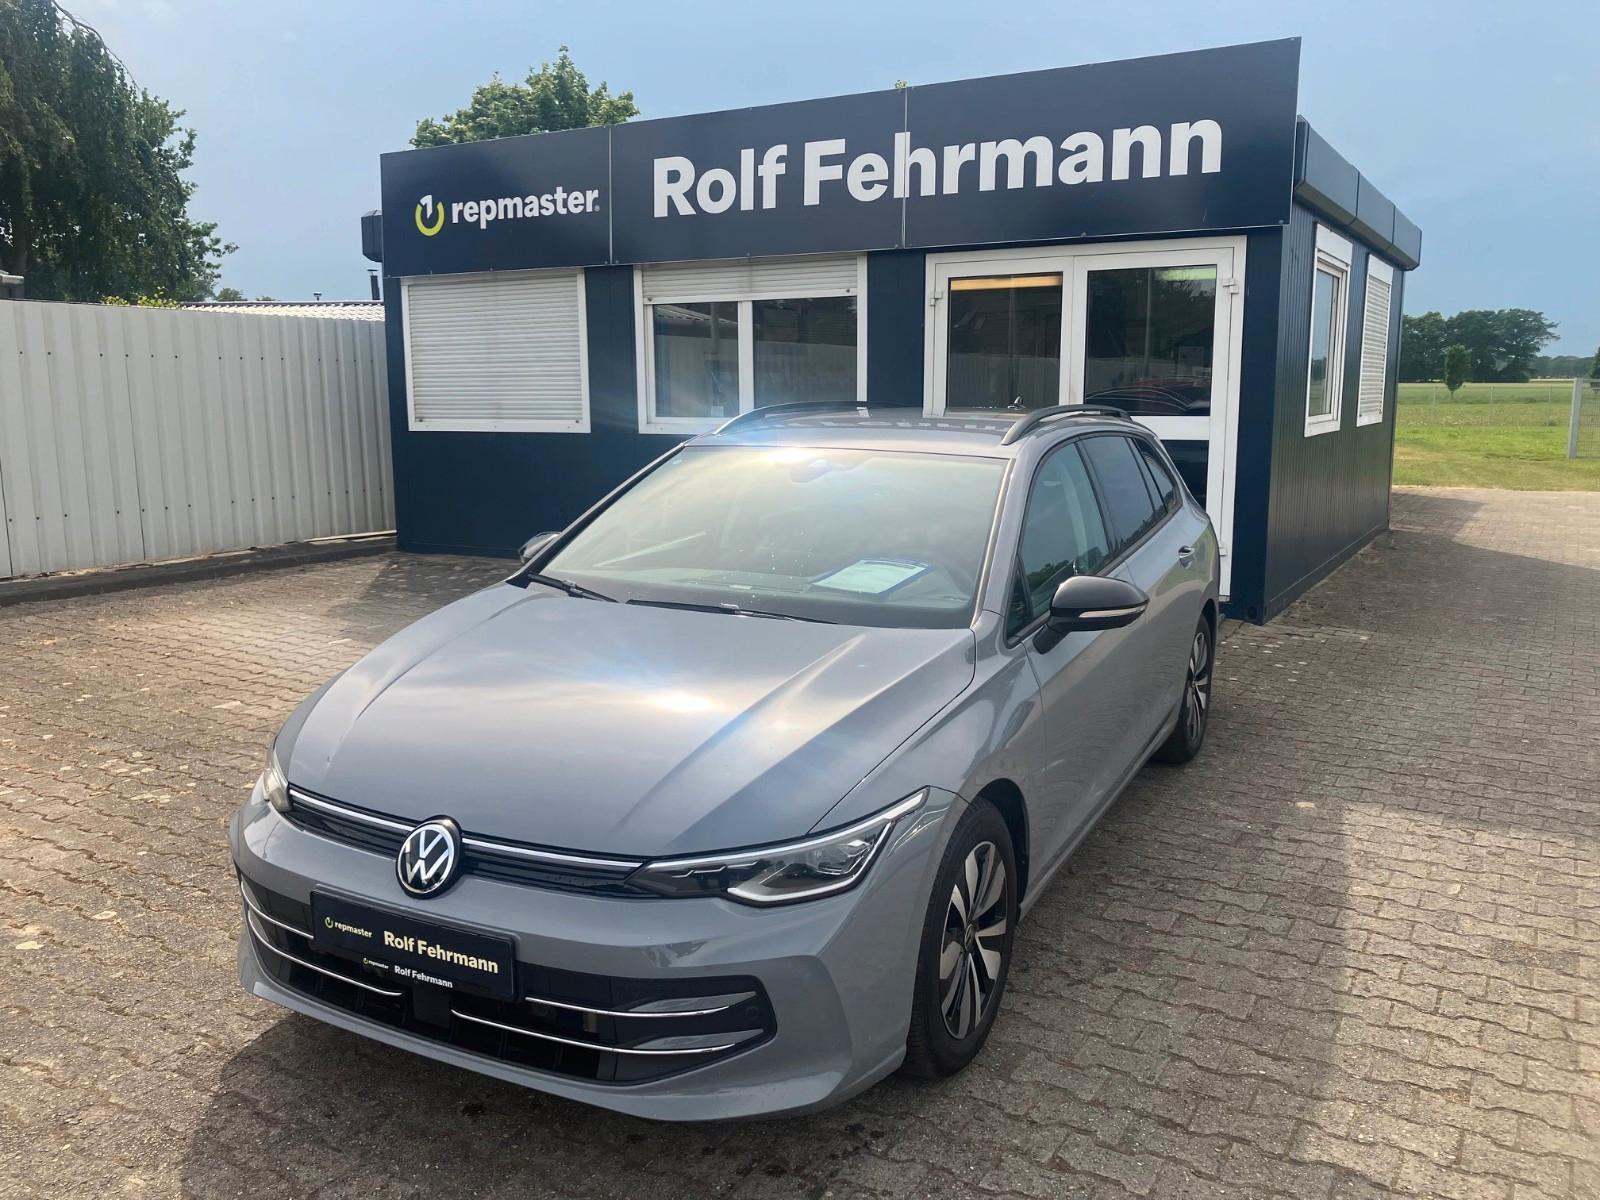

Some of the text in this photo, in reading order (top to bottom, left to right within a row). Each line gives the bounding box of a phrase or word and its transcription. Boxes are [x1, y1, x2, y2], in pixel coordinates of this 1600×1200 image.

[652, 118, 1223, 218] Rolf Fehrmann
[402, 827, 452, 888] VW
[334, 921, 373, 938] repmaster
[383, 930, 499, 974] Rolf Fehrmann
[394, 965, 453, 988] Rolf Fehrmann
